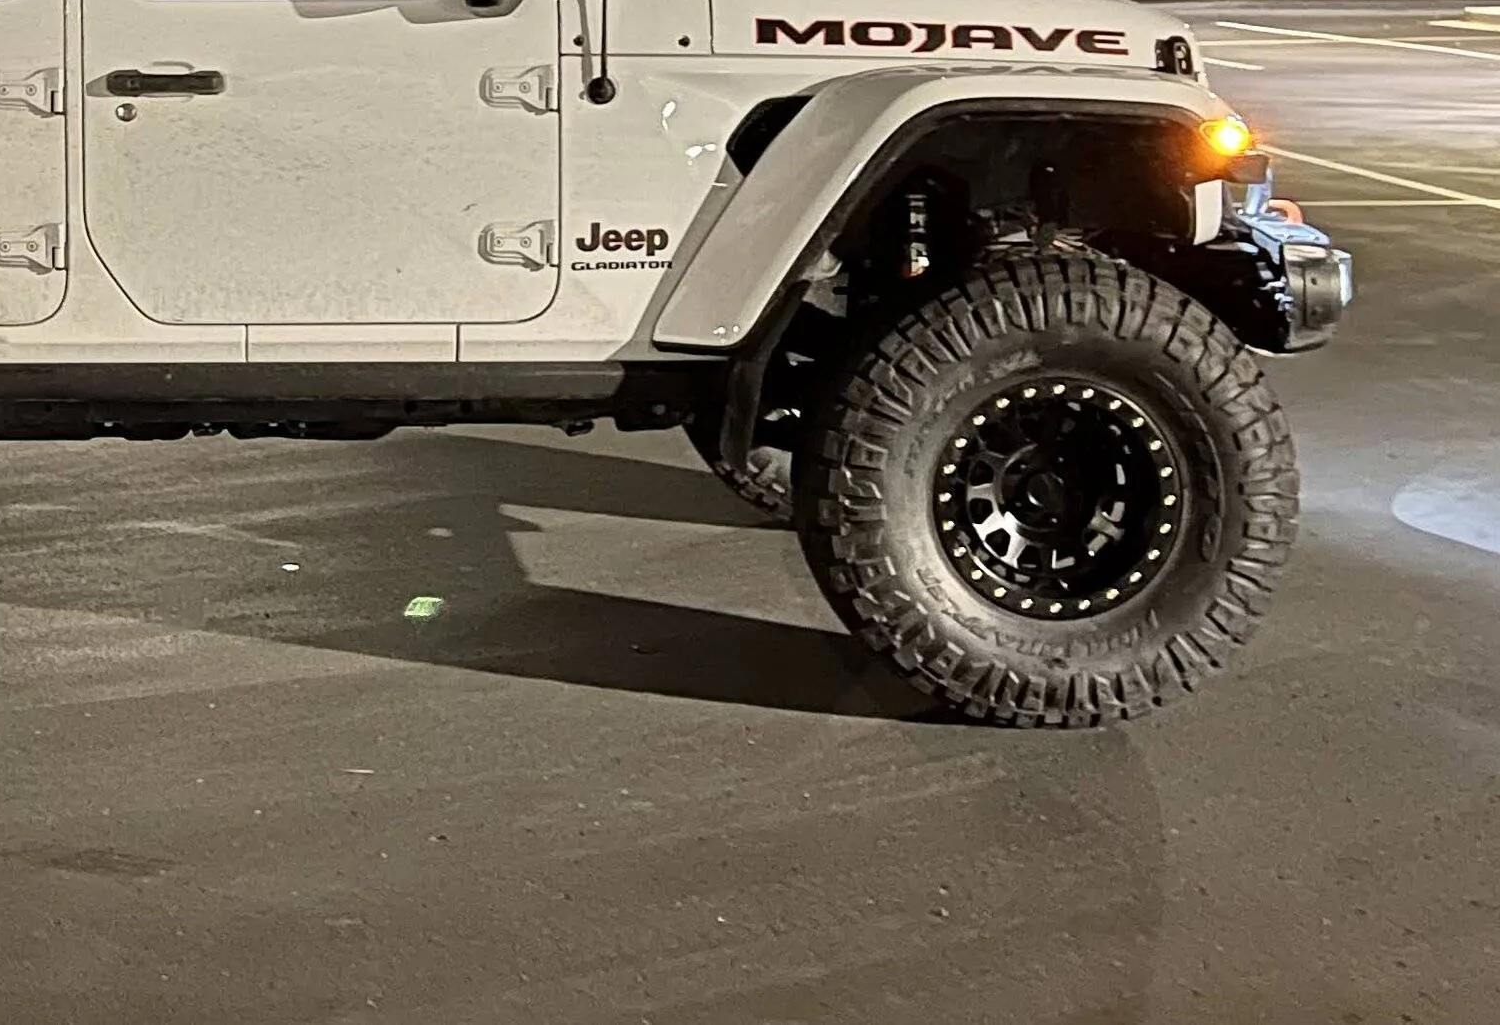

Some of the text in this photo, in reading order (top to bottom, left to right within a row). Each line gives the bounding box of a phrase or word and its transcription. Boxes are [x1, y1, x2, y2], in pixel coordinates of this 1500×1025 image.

[755, 18, 1129, 55] MOJAVE
[575, 222, 669, 257] Jeep
[570, 260, 673, 271] GLADIATOR
